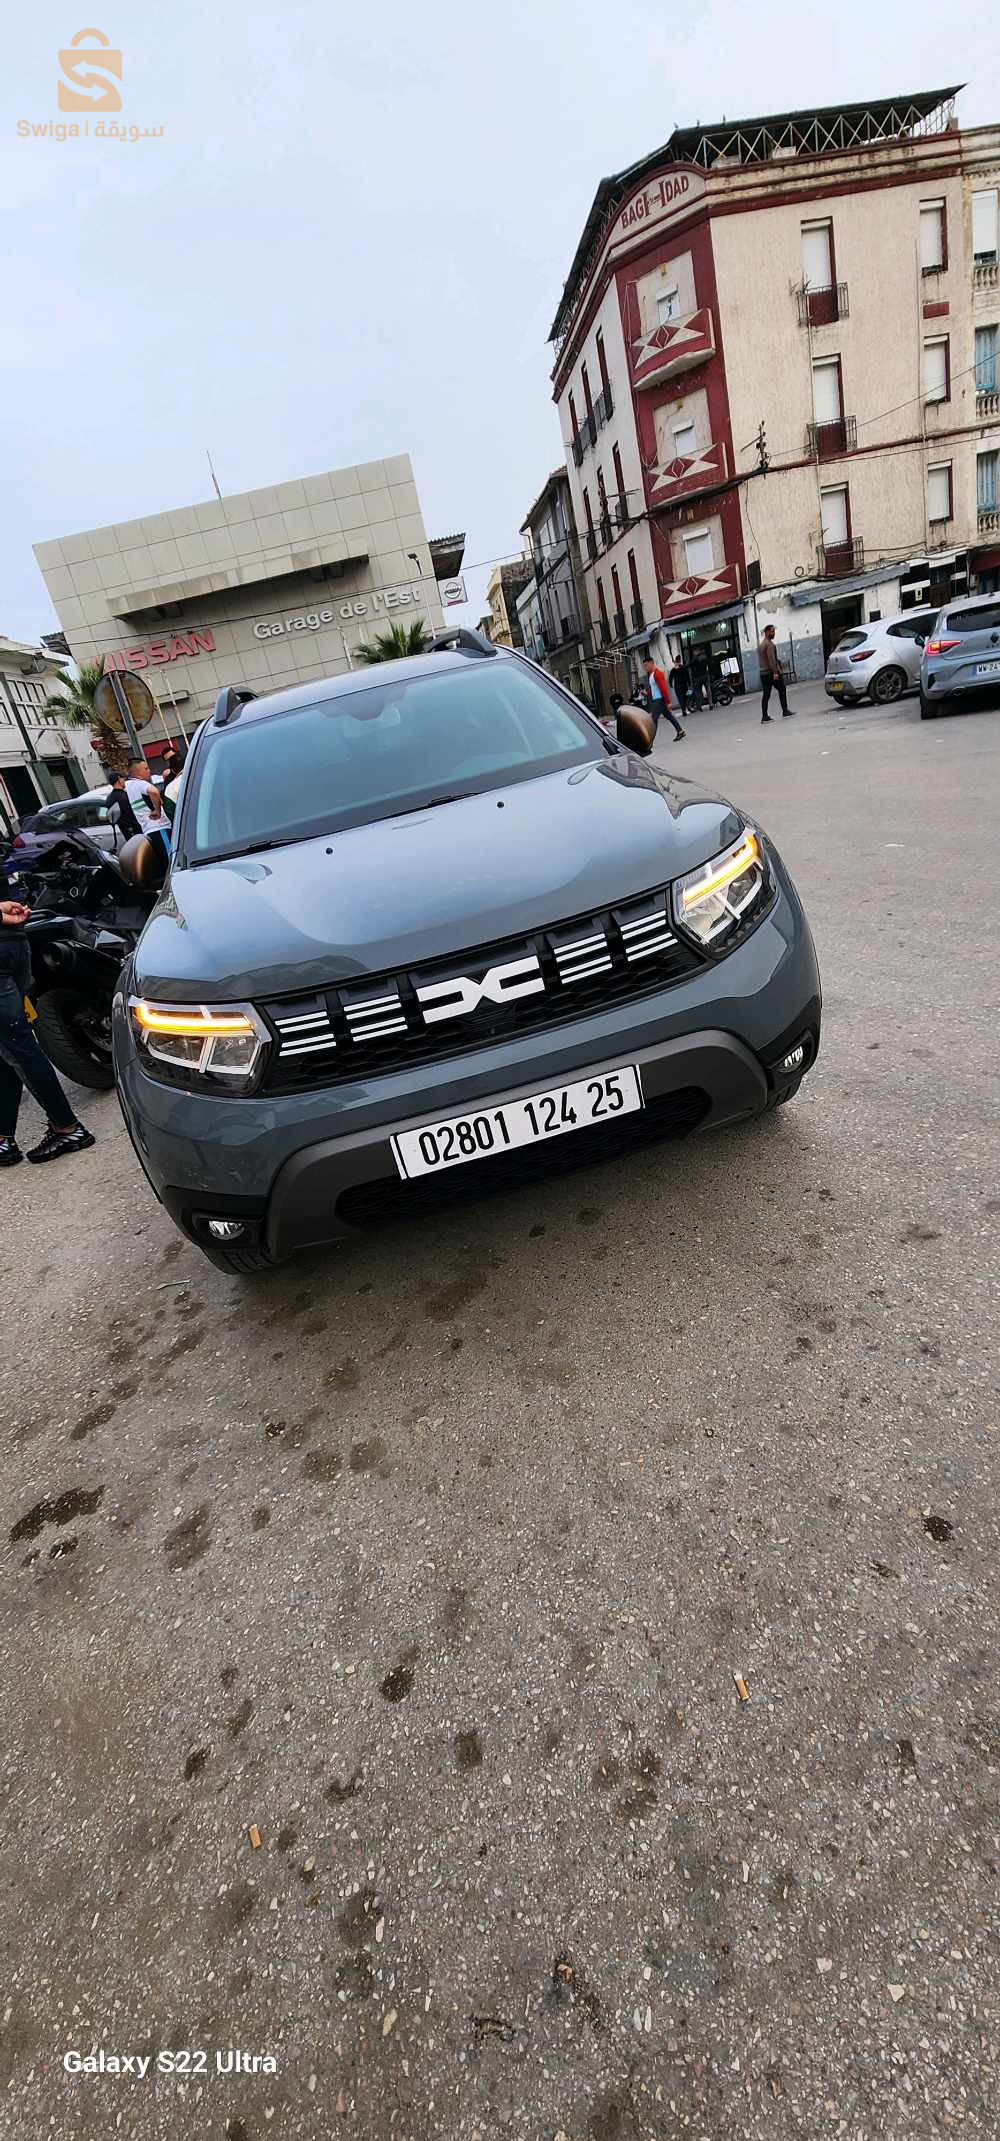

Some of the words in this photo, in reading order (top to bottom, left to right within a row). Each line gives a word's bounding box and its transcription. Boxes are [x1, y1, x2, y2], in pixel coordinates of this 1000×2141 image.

[253, 608, 334, 640] Garage
[339, 602, 368, 619] de
[371, 588, 421, 612] l'Est
[418, 1110, 511, 1166] 02801
[523, 1091, 578, 1136] 124
[586, 1075, 624, 1118] 25
